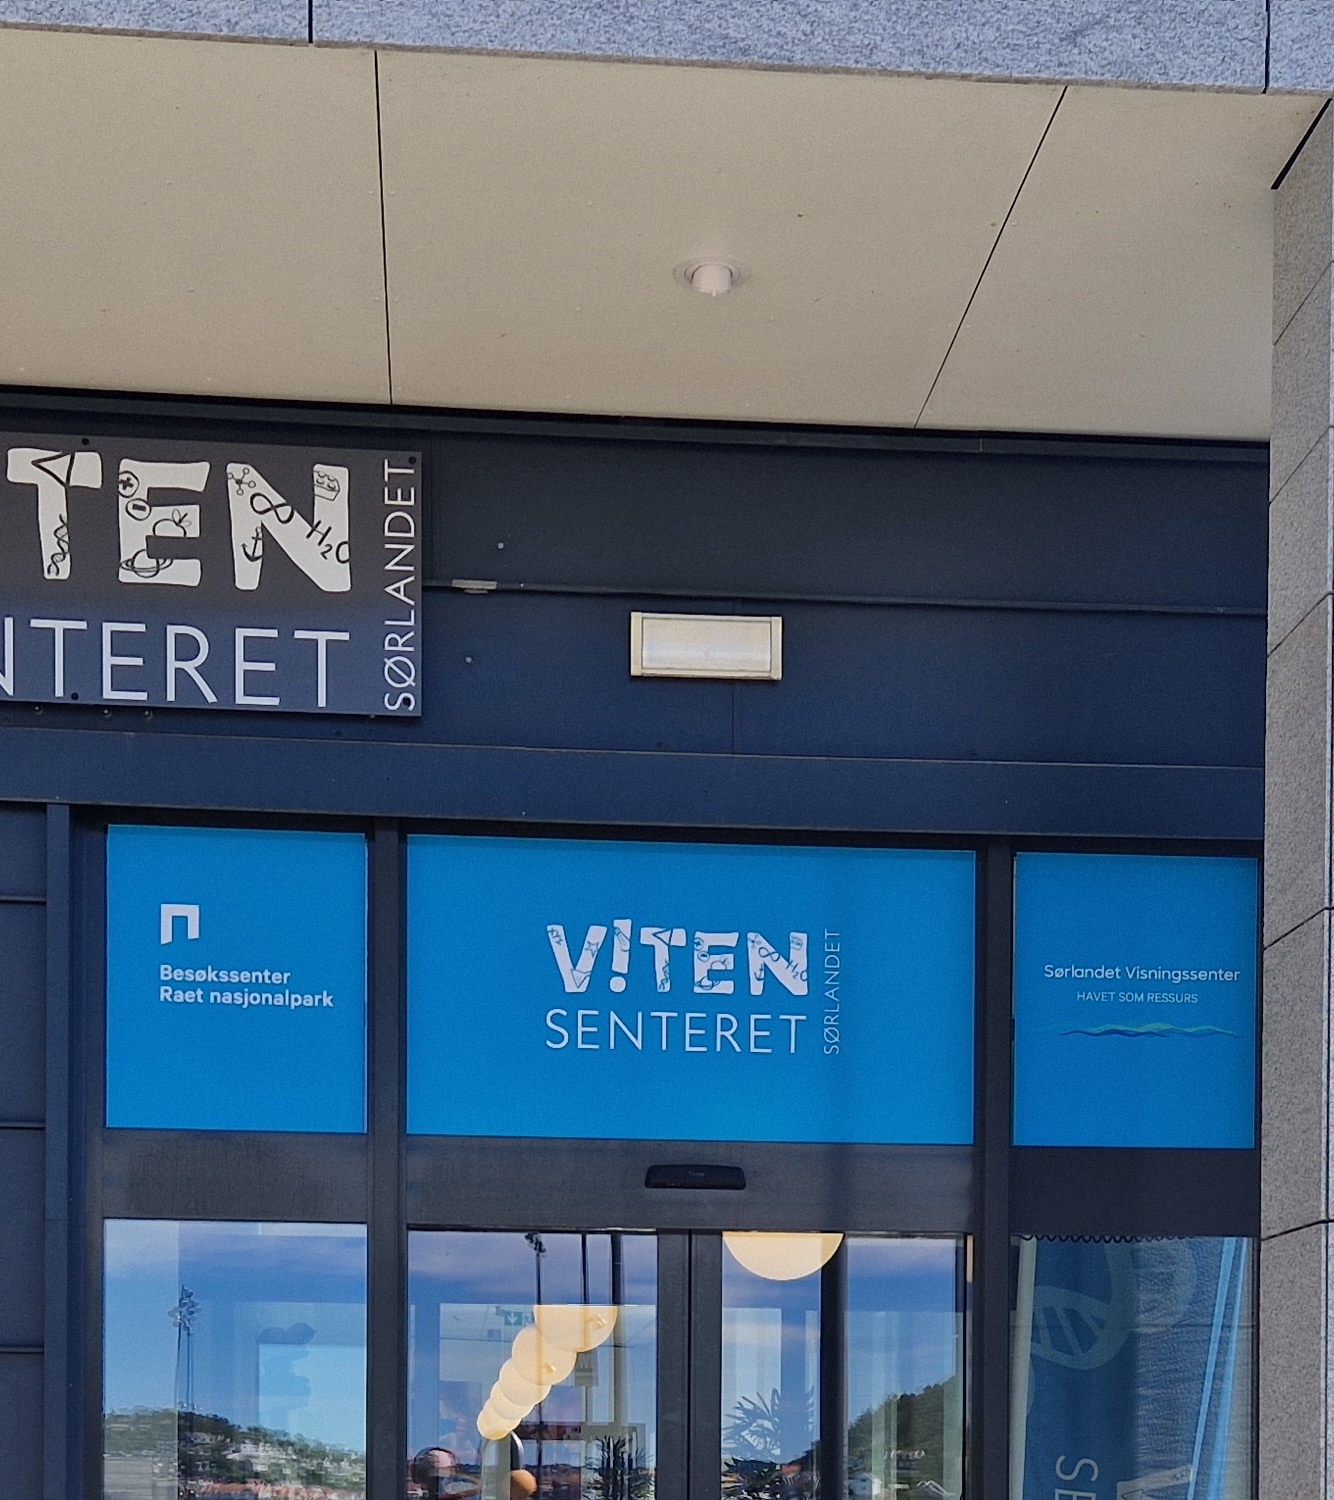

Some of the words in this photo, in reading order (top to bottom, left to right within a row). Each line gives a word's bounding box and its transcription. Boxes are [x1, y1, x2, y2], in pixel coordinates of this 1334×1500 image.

[384, 459, 415, 712] SØRLANDET
[160, 964, 291, 985] Besøkssenter
[1044, 964, 1121, 979] Sørlandet
[1125, 965, 1241, 983] Visningssenter
[160, 986, 204, 1003] Raet
[209, 989, 334, 1010] nasjonalpark
[824, 928, 841, 1055] SØRLANDET
[1077, 991, 1115, 1002] HAVET
[1118, 992, 1144, 1003] SOM
[1147, 993, 1198, 1004] RESSURS
[545, 1008, 807, 1054] SENTERET
